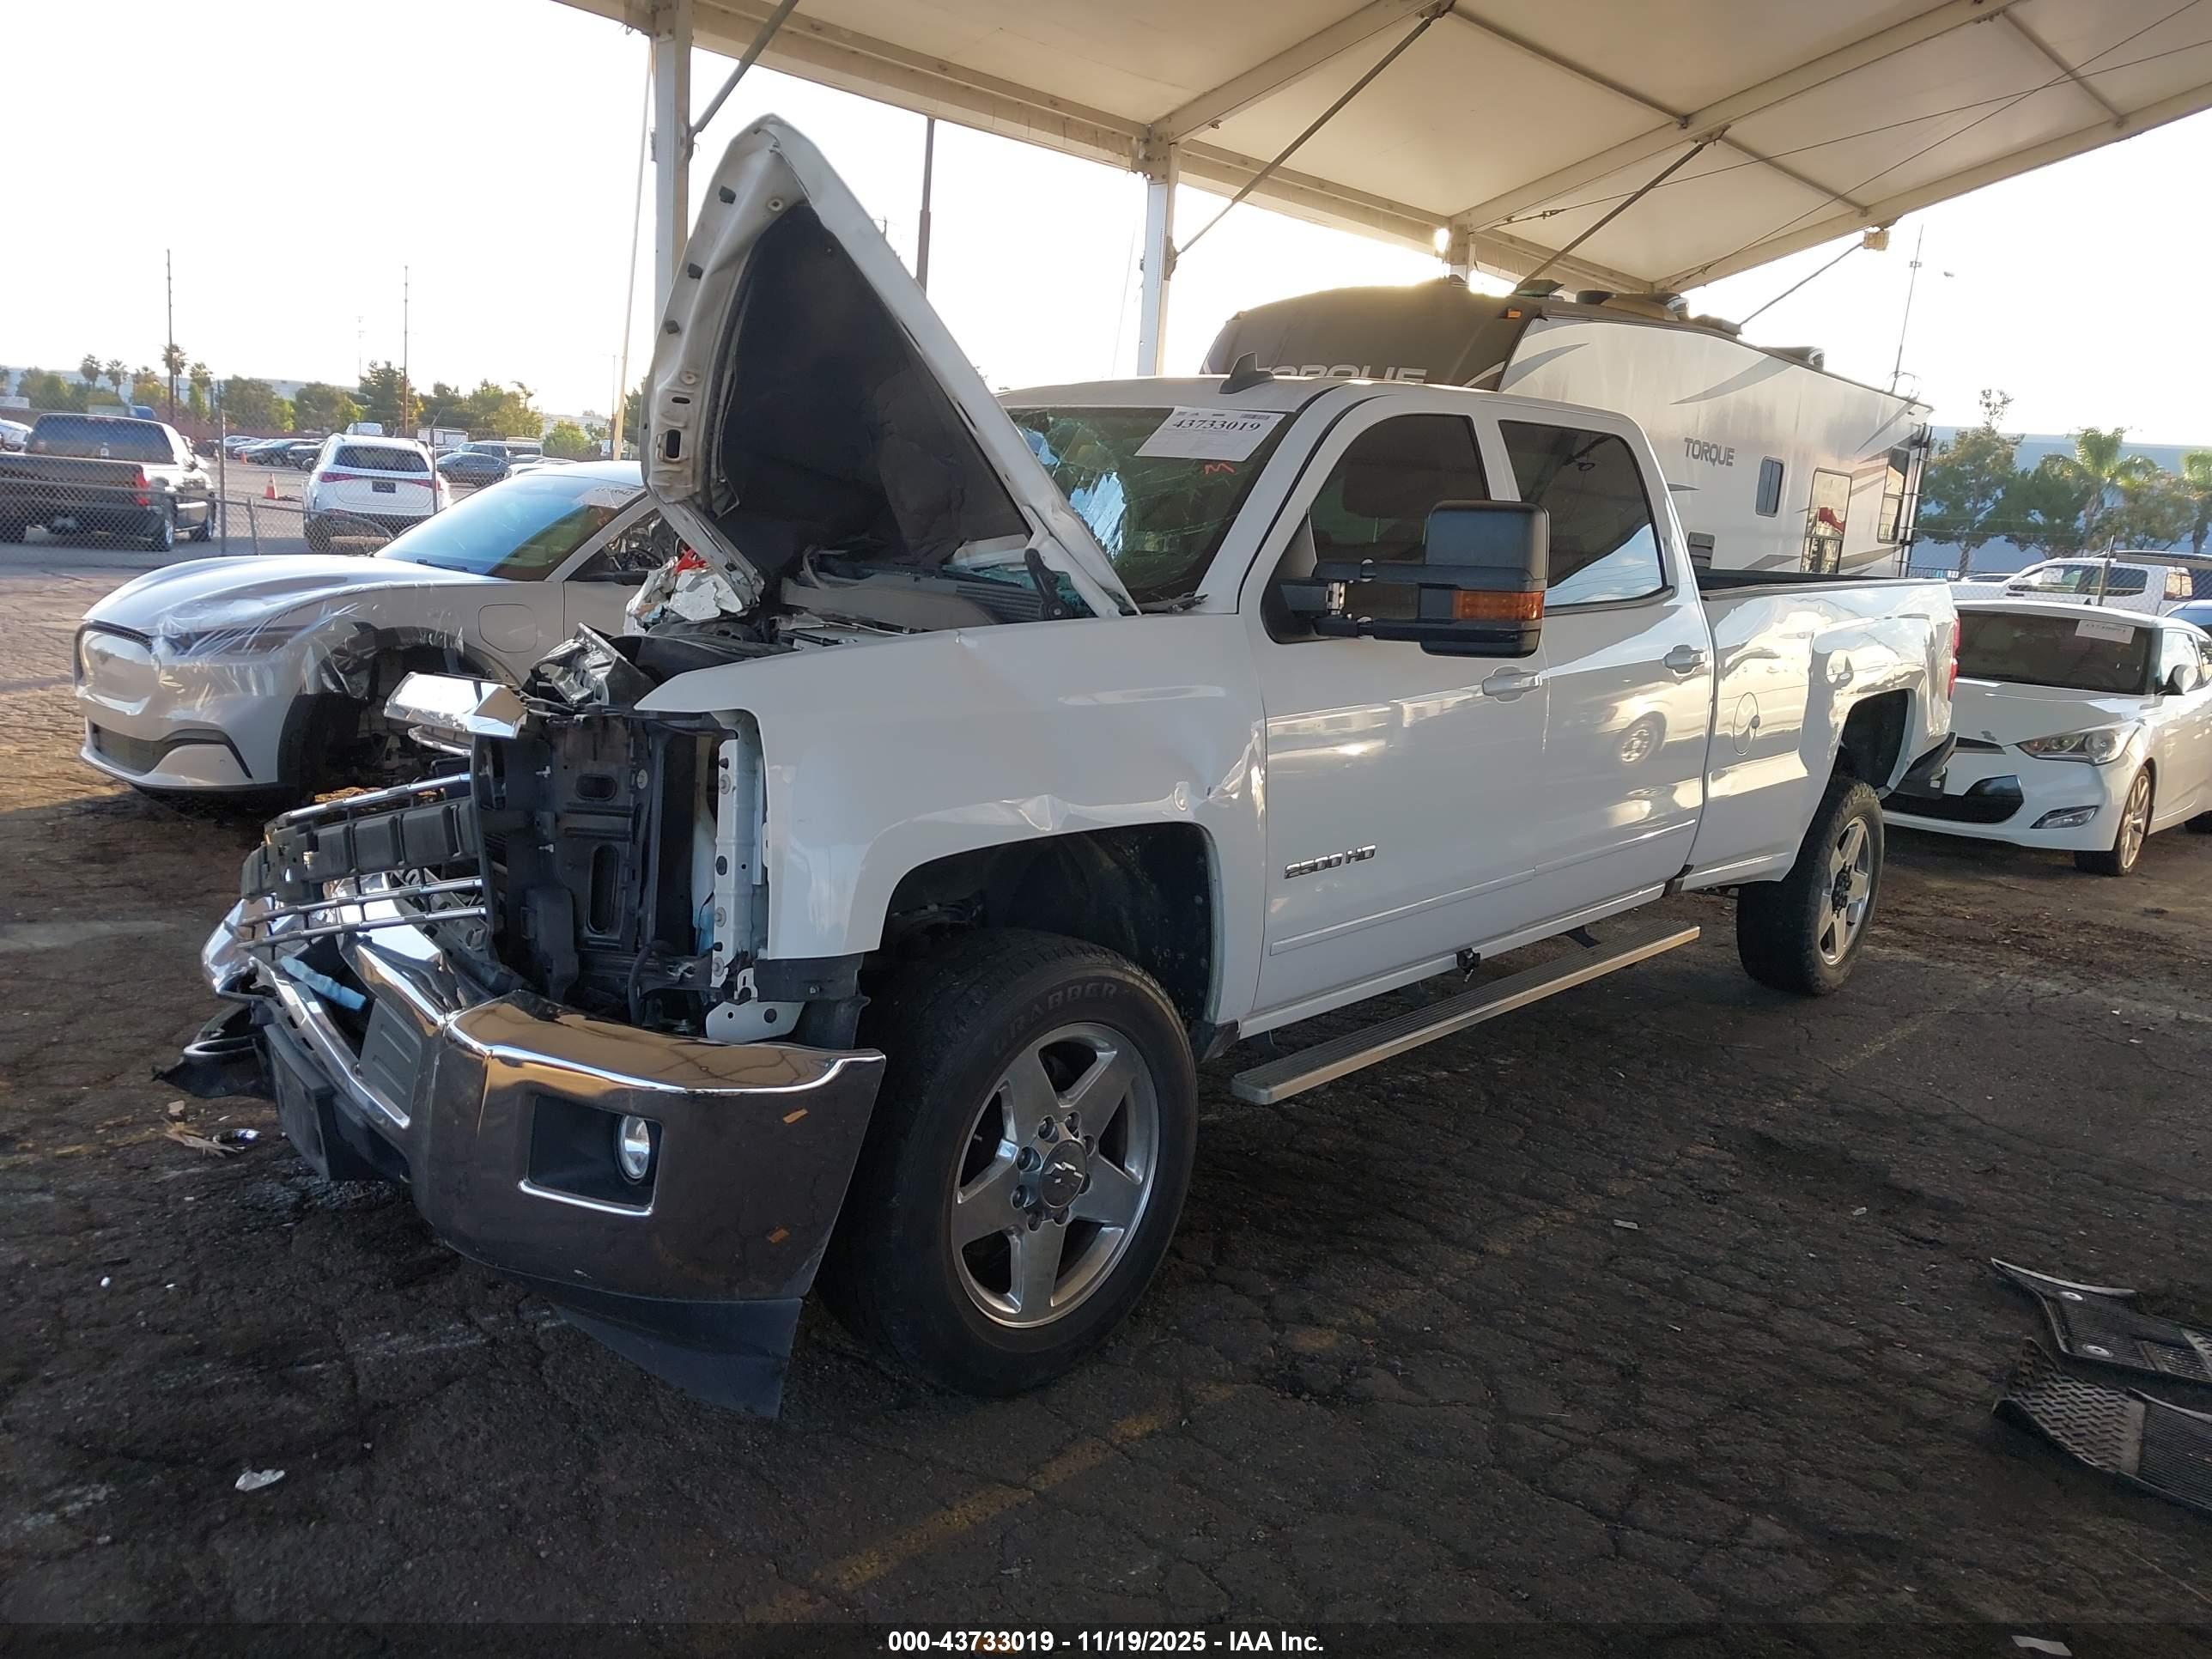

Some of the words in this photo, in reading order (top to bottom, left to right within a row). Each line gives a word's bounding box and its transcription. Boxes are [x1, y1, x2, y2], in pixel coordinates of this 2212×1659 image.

[1172, 417, 1261, 432] 43733019
[1683, 436, 1736, 467] TORQUE
[1284, 853, 1343, 879] 2500
[1346, 844, 1377, 865] HD
